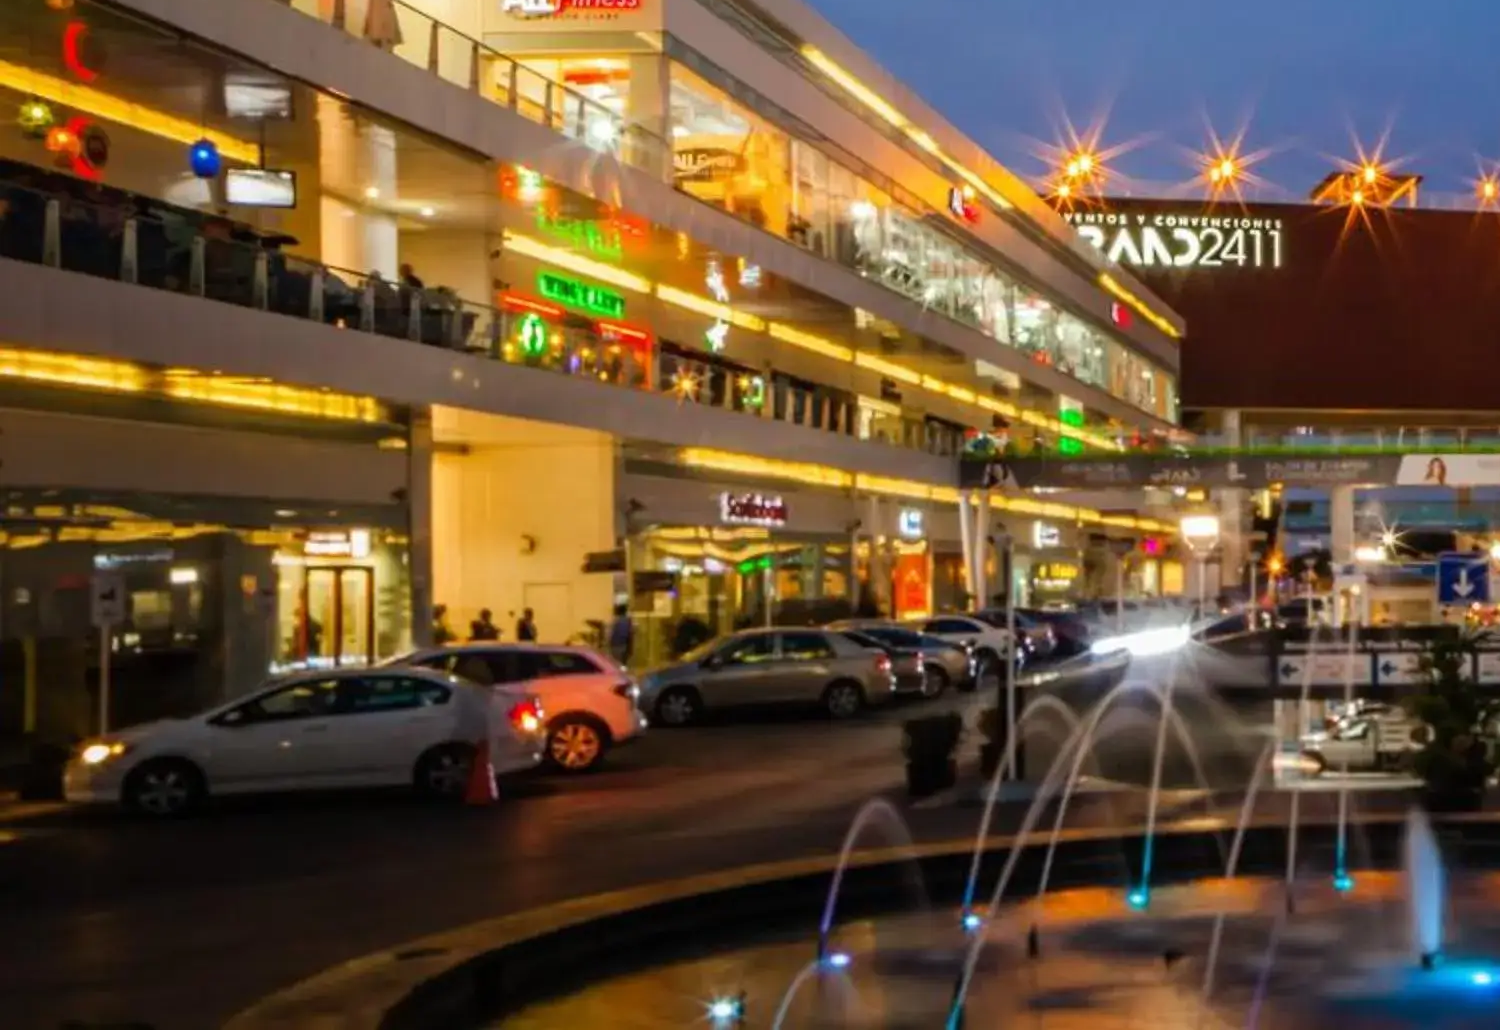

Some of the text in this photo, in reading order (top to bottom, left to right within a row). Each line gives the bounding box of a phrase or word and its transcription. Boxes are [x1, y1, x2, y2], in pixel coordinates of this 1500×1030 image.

[1062, 212, 1283, 230] VENTOS Y CONVENCIONES
